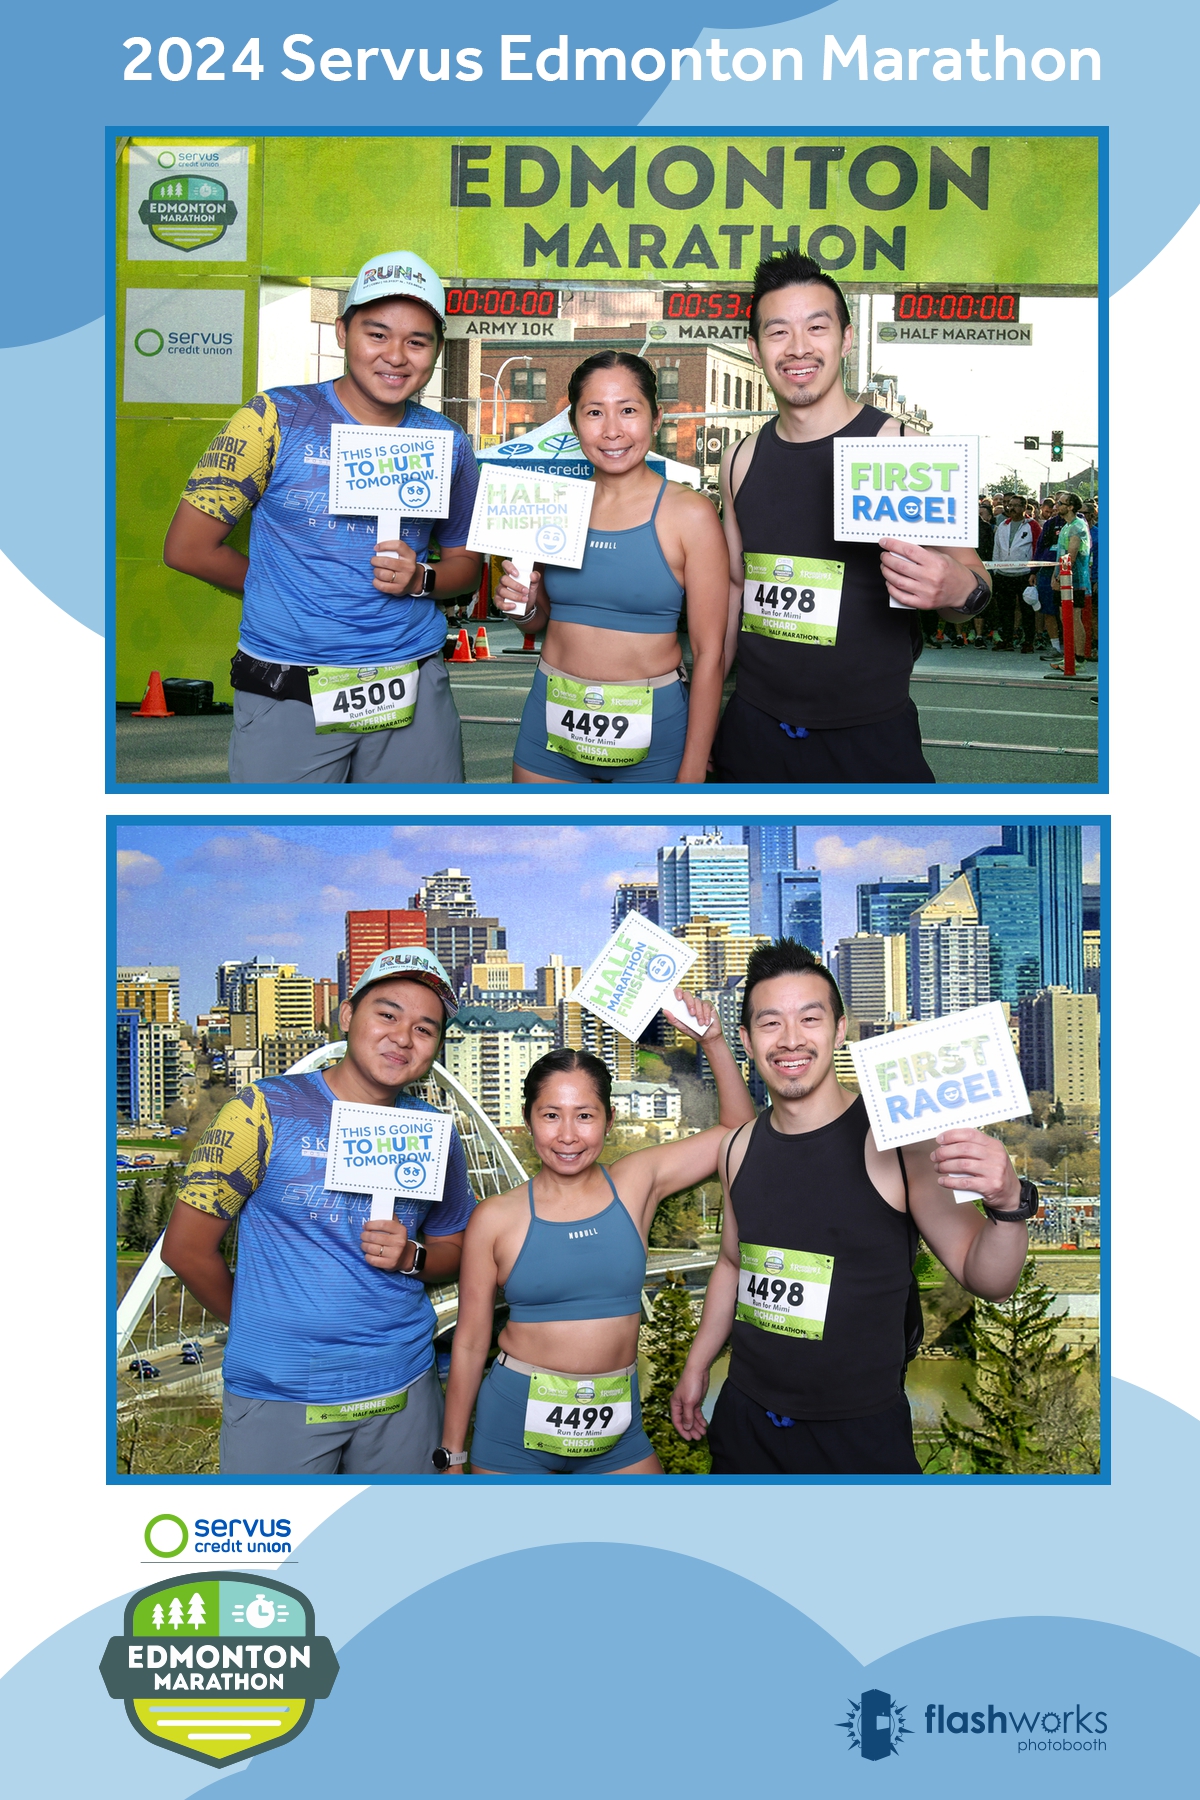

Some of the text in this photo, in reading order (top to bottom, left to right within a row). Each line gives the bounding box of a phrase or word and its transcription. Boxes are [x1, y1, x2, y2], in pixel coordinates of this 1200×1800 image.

[178, 152, 219, 161] servus
[449, 144, 991, 212] EDMONTON
[149, 203, 227, 214] EDMONTON
[160, 214, 215, 222] MARATHON
[523, 222, 907, 271] MARATHON
[363, 265, 426, 285] RUN+
[465, 321, 554, 336] ARMY 10K
[678, 324, 750, 339] MARATH
[900, 328, 1031, 341] HALF MARATHON
[168, 332, 233, 345] servus
[168, 345, 233, 355] credit union
[341, 440, 435, 461] THIS IS GOING
[344, 452, 435, 478] TO HURT
[548, 463, 590, 476] credit
[346, 469, 439, 491] TOMORROW.
[851, 462, 959, 492] FIRST
[486, 482, 569, 505] HALF
[486, 503, 568, 517] MARATHON
[852, 495, 957, 524] RACE!
[308, 518, 421, 537] RUNNRS
[486, 515, 569, 530] FINISHER!
[589, 540, 617, 549] NOBULL
[754, 584, 816, 613] 4498
[761, 608, 802, 620] Run for Mimi
[762, 618, 798, 631] RICHARD
[782, 631, 819, 641] MARATHON
[332, 678, 406, 714] 4500
[349, 702, 396, 719] Run for Mimi
[348, 711, 397, 729] ANFERNEE
[380, 715, 412, 728] MARATHON
[560, 709, 630, 740] 4499
[570, 733, 616, 746] Run for Mimi
[576, 744, 609, 756] CHISSA
[379, 954, 441, 976] RUN+
[589, 932, 635, 1007] HALF
[606, 941, 647, 1012] MARATHON
[616, 945, 660, 1018] FINISHER!
[875, 1034, 990, 1093] FIRST
[885, 1069, 1003, 1124] RACE!
[340, 1122, 434, 1138] THIS IS GOING
[343, 1135, 433, 1155] TO HURT
[191, 1146, 224, 1164] UNNER
[343, 1151, 435, 1168] TOMORROW.
[568, 1227, 599, 1240] NOBULL
[746, 1274, 804, 1307] 4498
[752, 1299, 790, 1313] Run for Mimi
[753, 1309, 786, 1324] RICHARD
[759, 1320, 807, 1335] HALF MARATHON
[340, 1399, 387, 1413] ANFERNEE
[368, 1404, 401, 1415] MARATHON
[545, 1405, 614, 1430] 4499
[556, 1429, 571, 1437] Run
[573, 1429, 583, 1437] for
[562, 1439, 595, 1447] CHISSA
[583, 1444, 614, 1454] MARATHON
